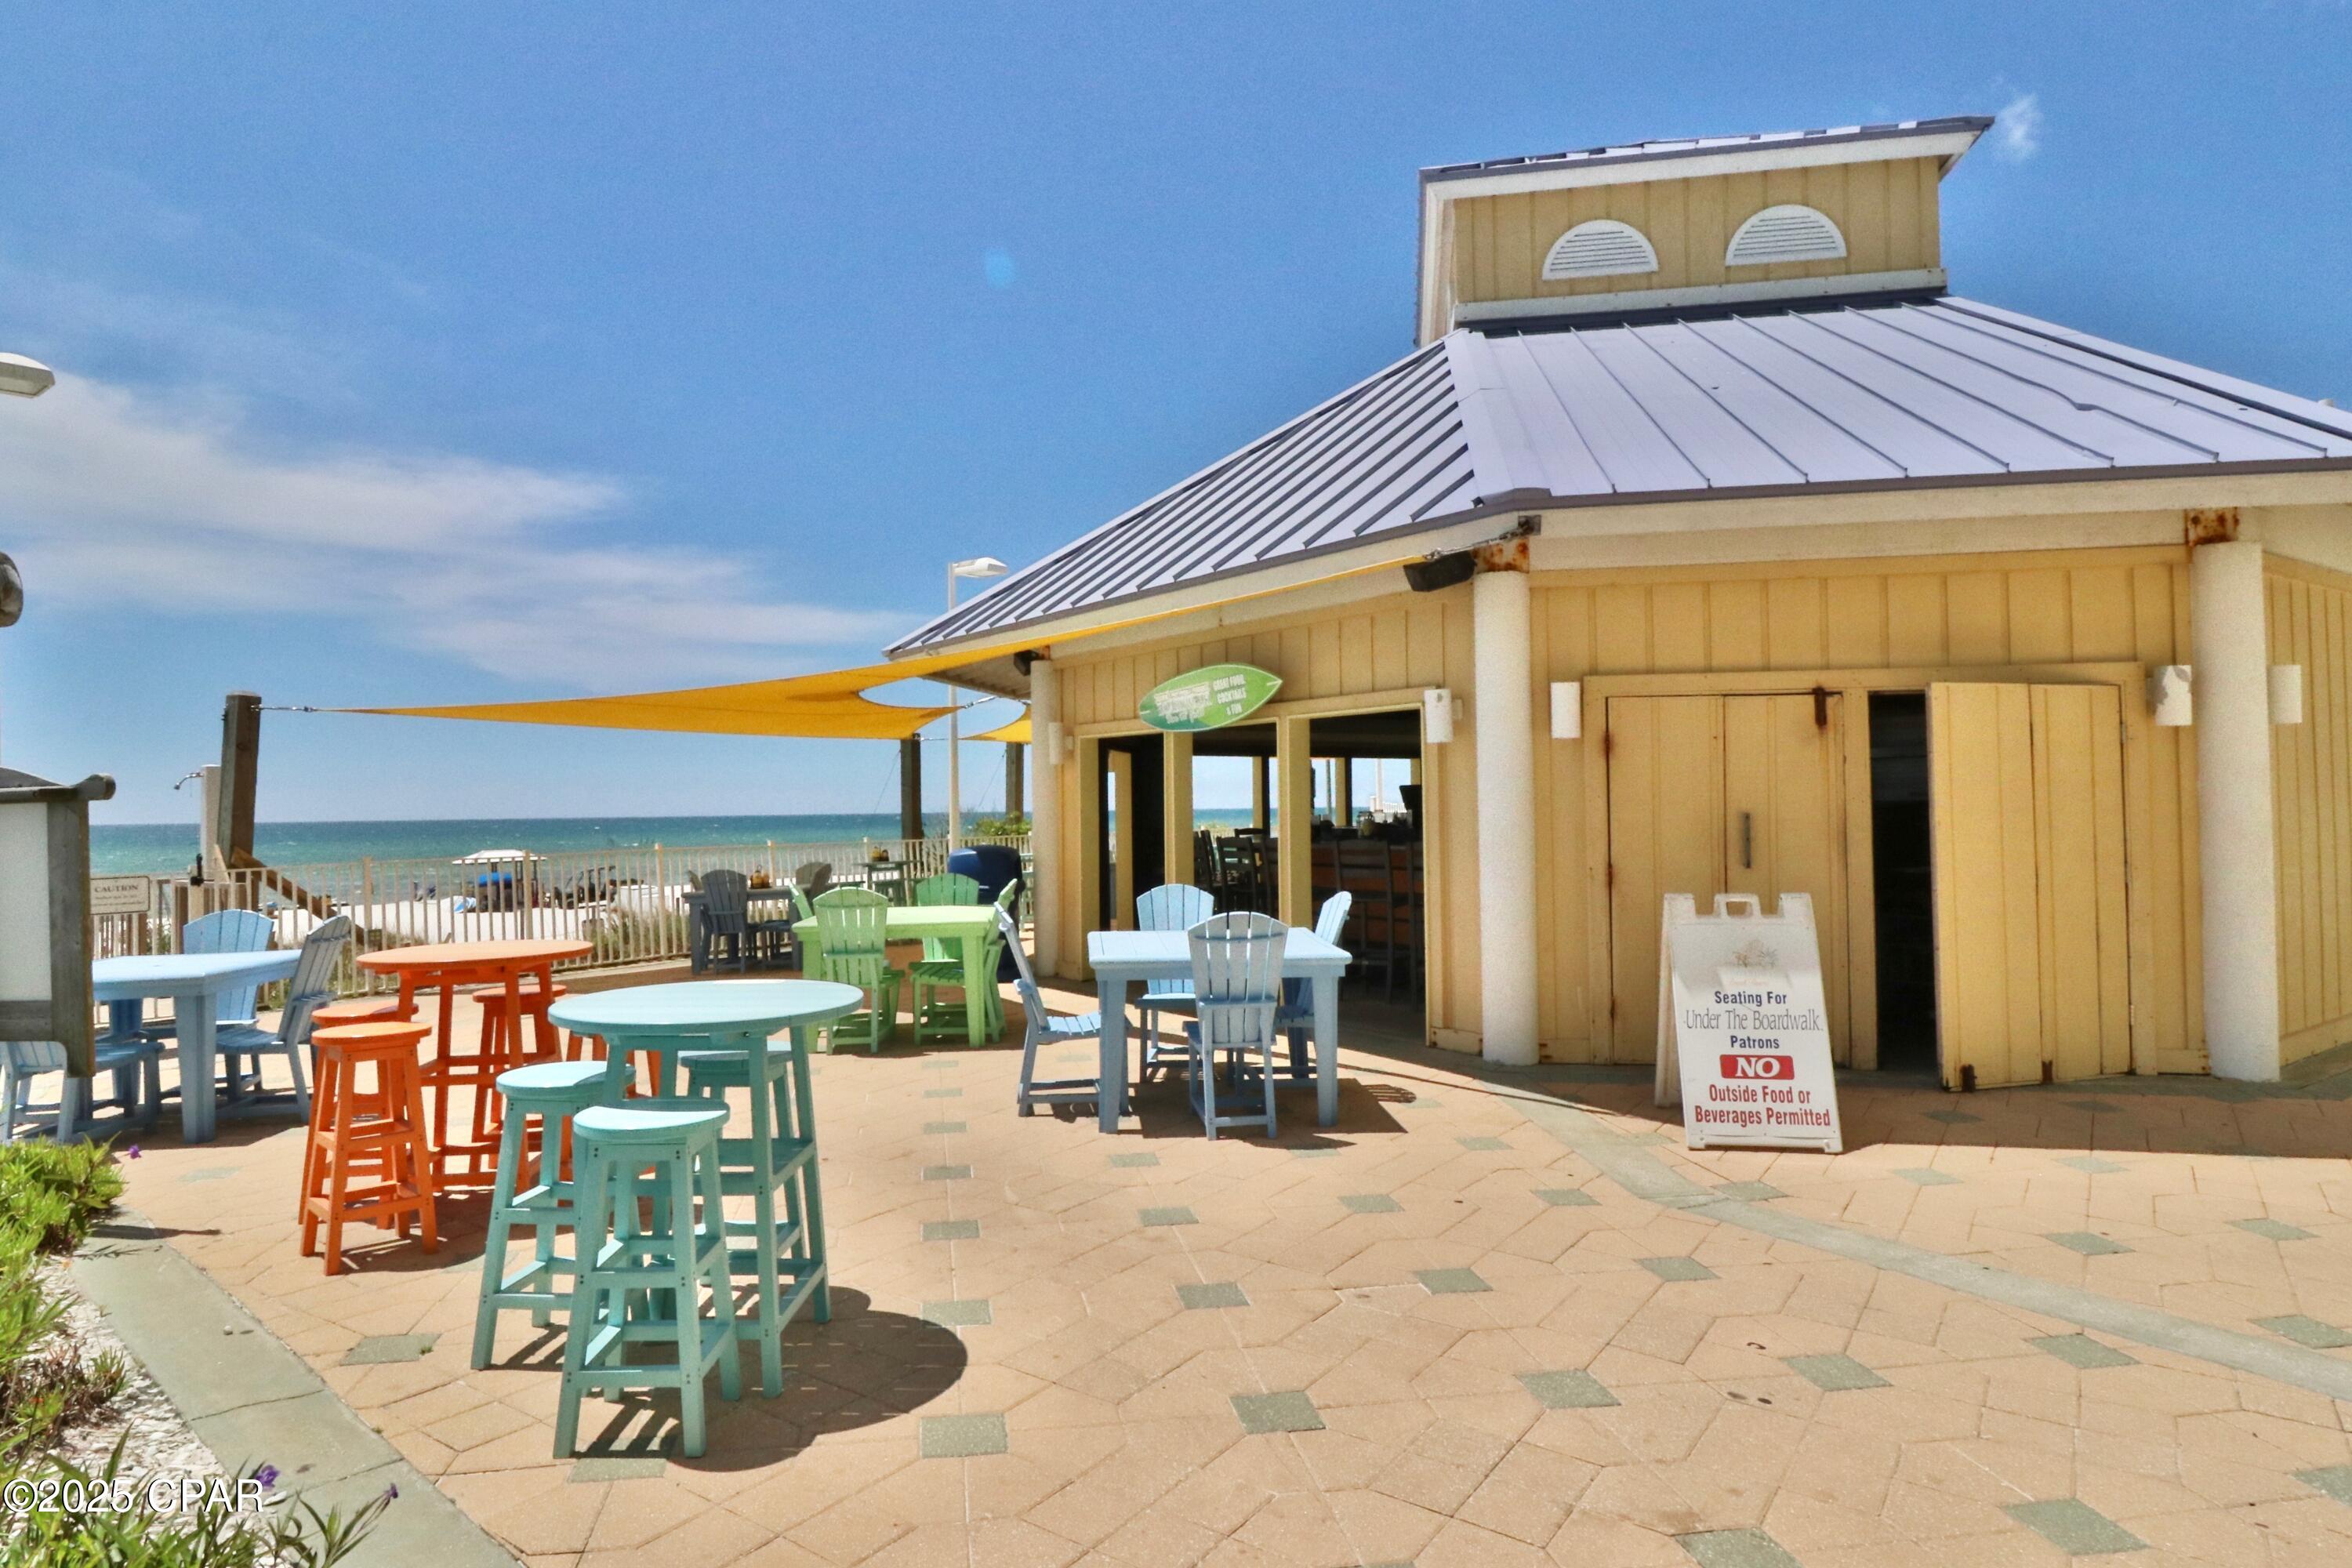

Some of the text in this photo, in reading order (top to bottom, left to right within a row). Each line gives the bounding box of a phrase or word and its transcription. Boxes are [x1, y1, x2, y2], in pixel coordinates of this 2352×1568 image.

[95, 884, 139, 893] CAUTION
[1714, 991, 1787, 1007] Seating For
[1686, 1008, 1721, 1029] Under
[1725, 1009, 1748, 1029] The
[1730, 1035, 1780, 1049] Patrons
[1735, 1057, 1780, 1077] NO
[1709, 1084, 1810, 1104] Outside Food or
[1695, 1105, 1831, 1127] Beverages Permitted
